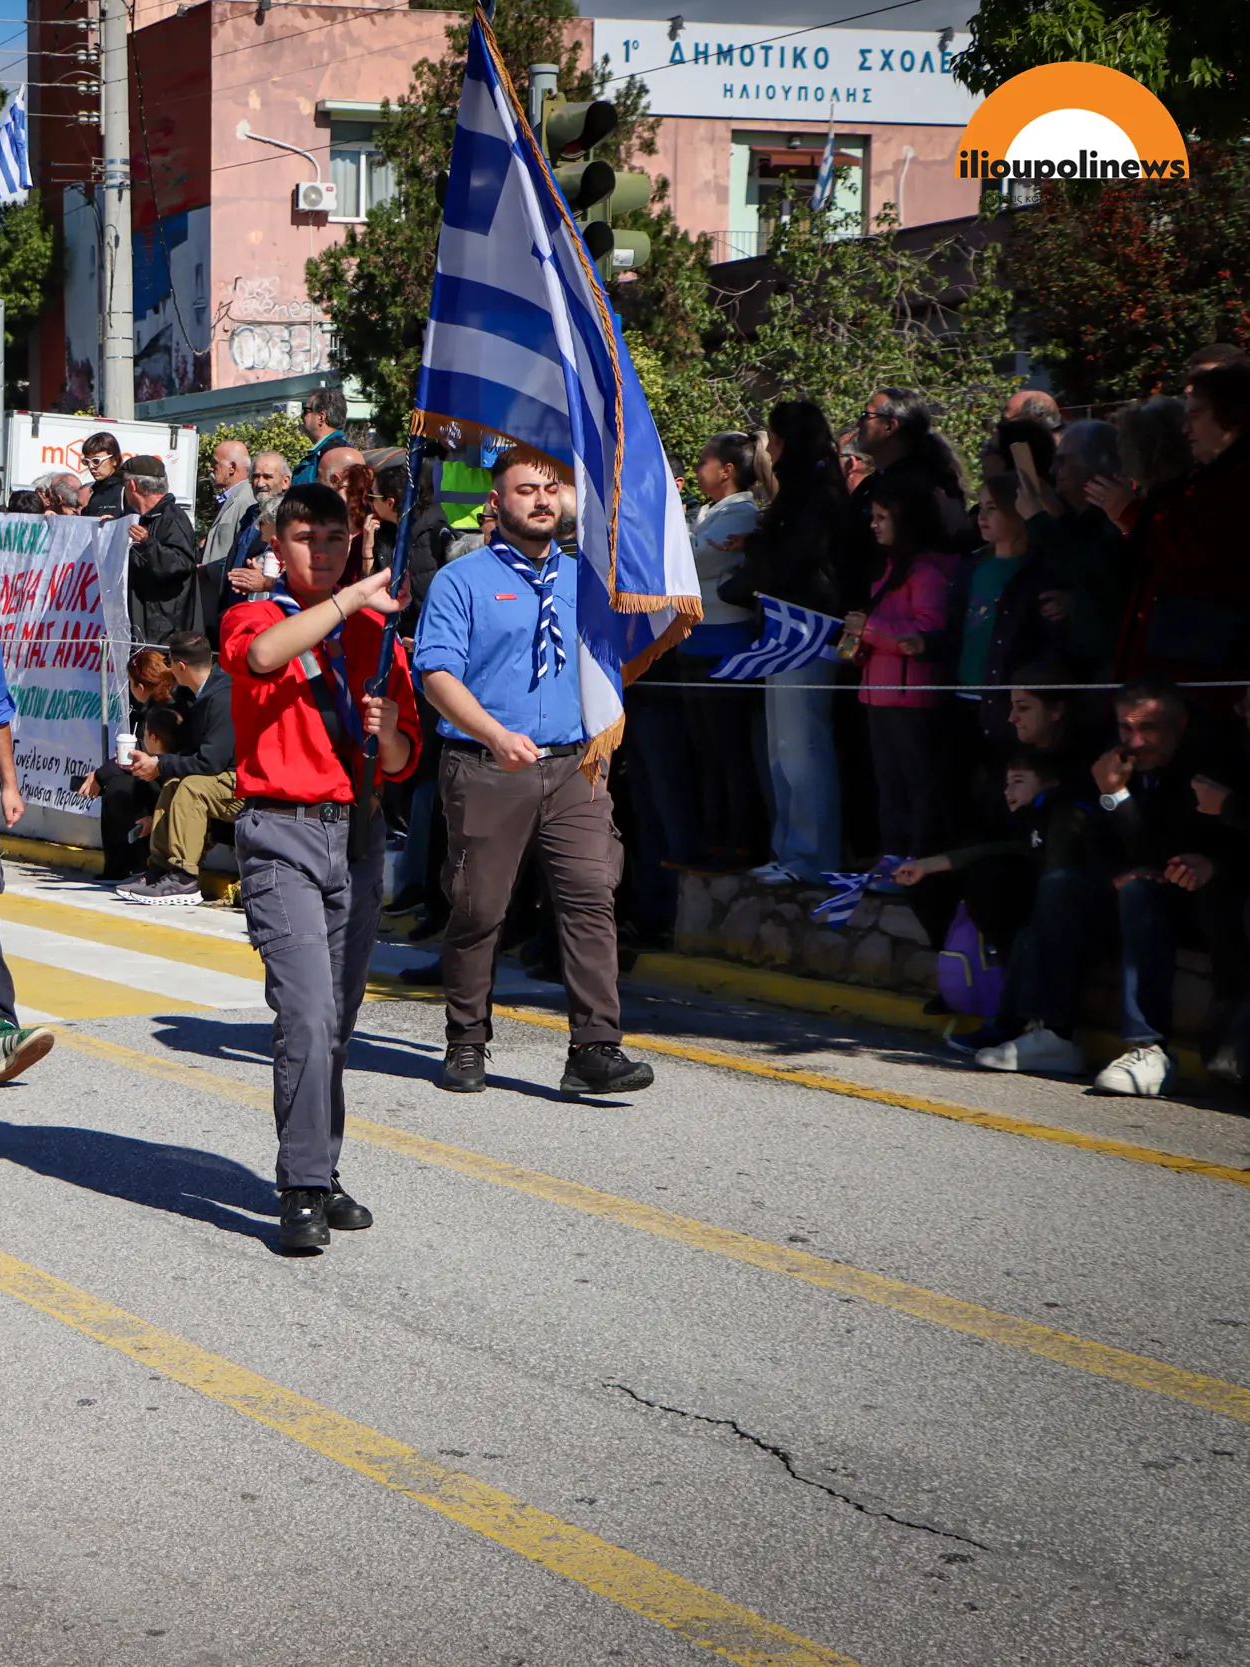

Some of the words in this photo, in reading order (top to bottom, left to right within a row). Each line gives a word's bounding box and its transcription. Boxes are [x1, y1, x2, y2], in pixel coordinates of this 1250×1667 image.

[669, 41, 830, 70] ΔΗΜΟΤΙΚΟ
[857, 48, 953, 74] ΣΧΟΛΕ
[723, 83, 873, 103] ΗΛΙΟΥΠΟΛΗΣ
